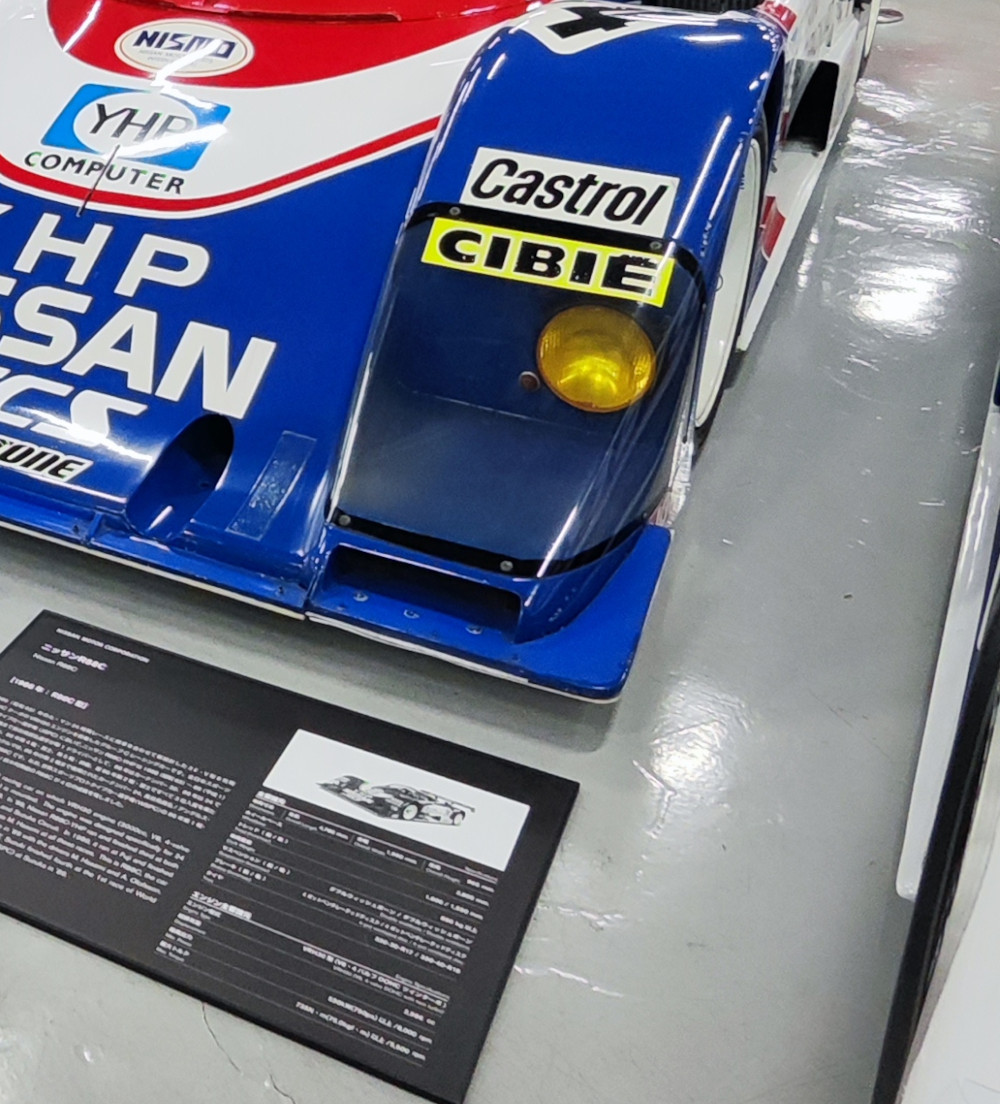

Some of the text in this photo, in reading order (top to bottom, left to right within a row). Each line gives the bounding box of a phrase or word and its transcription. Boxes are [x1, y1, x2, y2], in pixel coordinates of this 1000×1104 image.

[132, 30, 237, 60] NISMO
[89, 103, 194, 142] YHP
[24, 151, 185, 195] COMPUTER
[470, 158, 670, 226] Castrol
